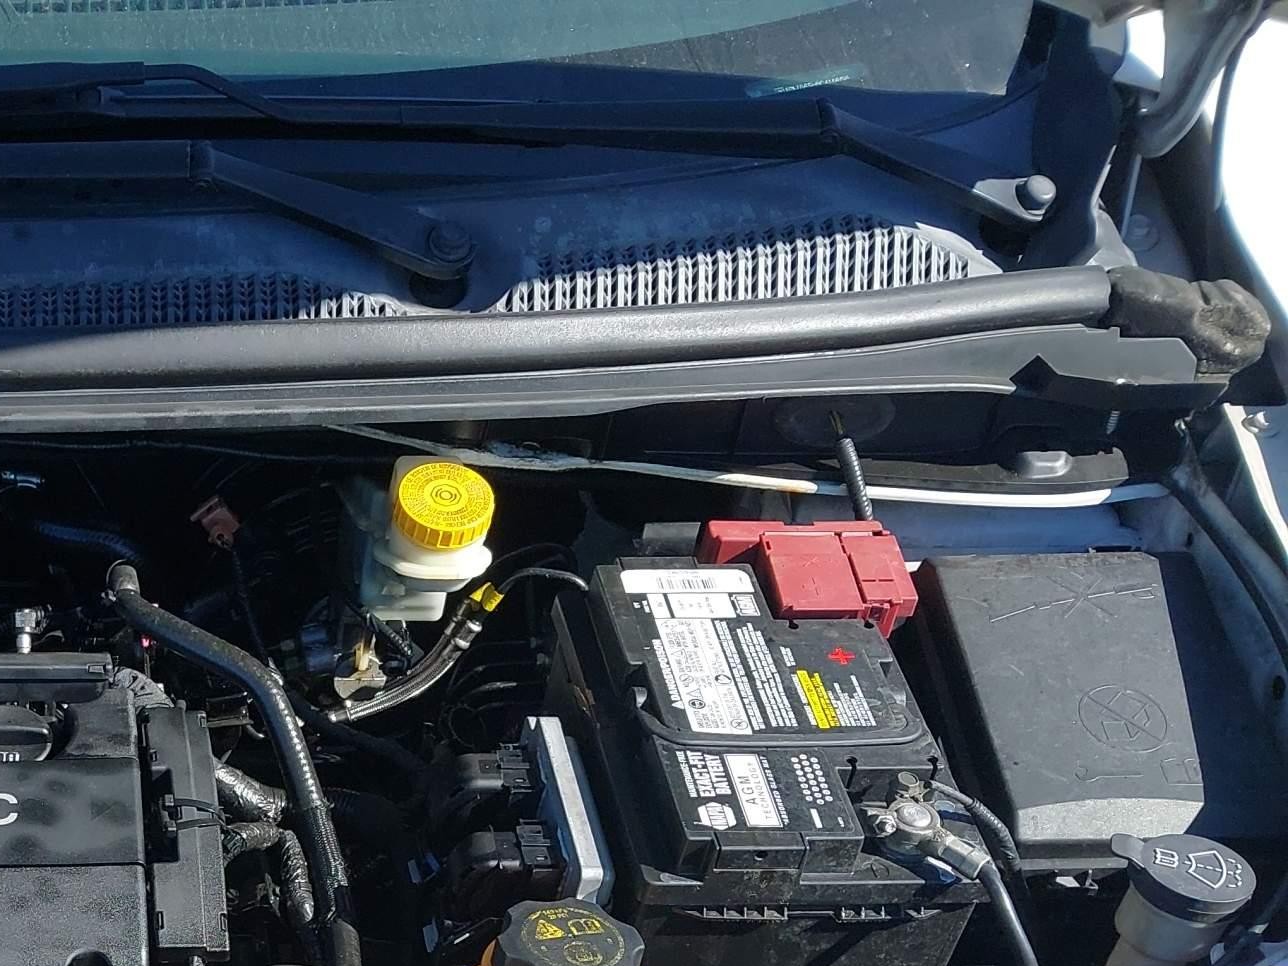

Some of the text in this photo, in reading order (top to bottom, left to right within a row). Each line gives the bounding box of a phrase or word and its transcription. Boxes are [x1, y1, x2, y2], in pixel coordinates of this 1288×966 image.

[686, 750, 716, 797] EXACT-FIT
[704, 754, 732, 795] BATTERY
[737, 775, 758, 806] AGM
[749, 762, 773, 820] TECHNOLOGY
